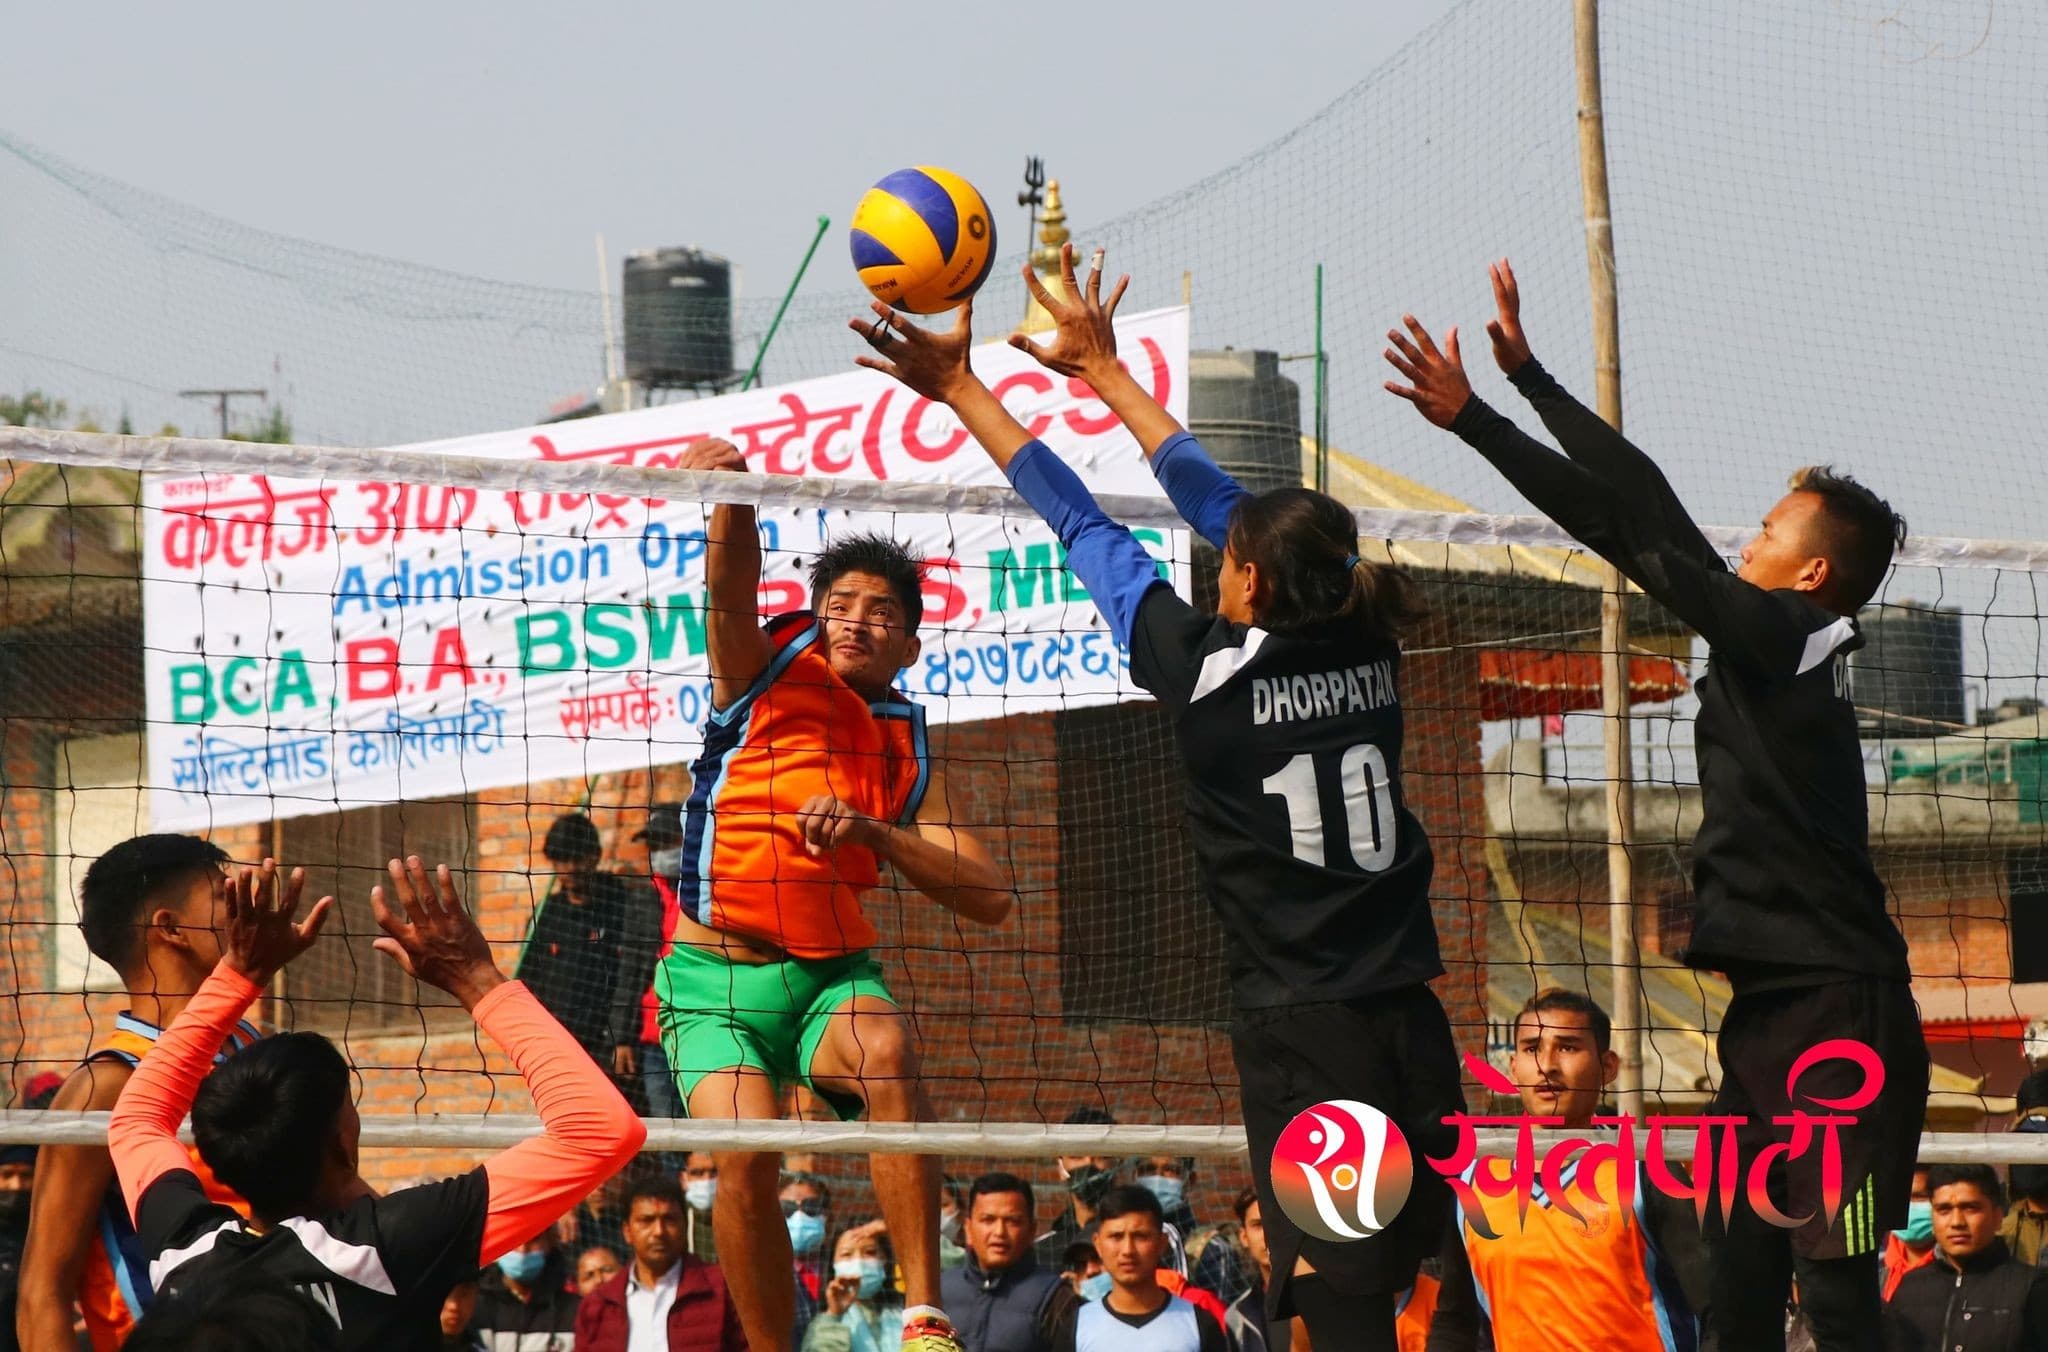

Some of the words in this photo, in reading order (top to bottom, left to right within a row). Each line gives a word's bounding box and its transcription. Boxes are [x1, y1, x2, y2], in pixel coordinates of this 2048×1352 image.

[333, 539, 609, 616] Admission
[637, 519, 779, 577] Opn
[1252, 659, 1397, 725] DHORPATAN
[1262, 743, 1397, 873] 10
